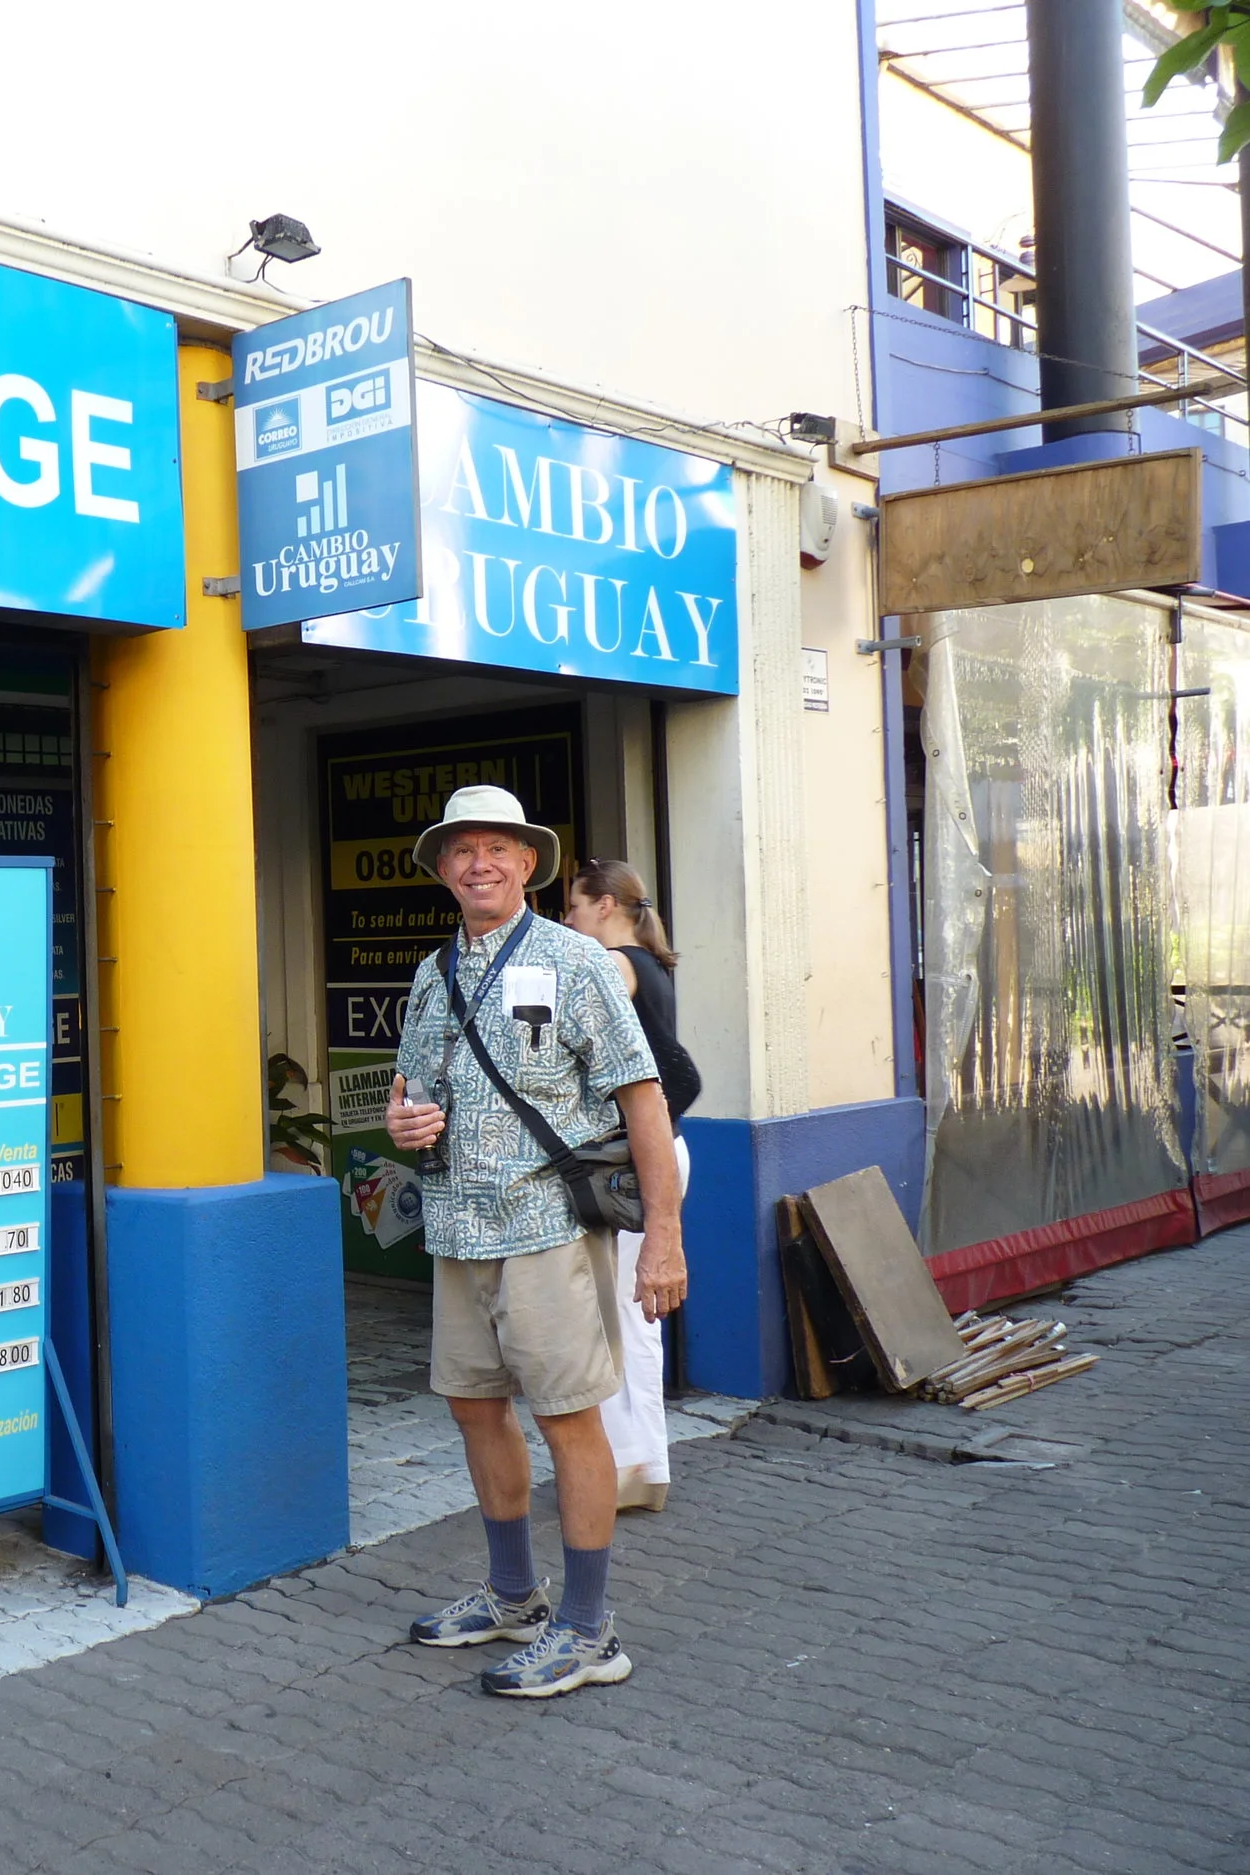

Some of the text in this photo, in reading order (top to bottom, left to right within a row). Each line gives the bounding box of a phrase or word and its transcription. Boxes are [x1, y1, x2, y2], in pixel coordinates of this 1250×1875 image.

[330, 376, 386, 419] DGI
[258, 426, 298, 445] CORREO
[423, 434, 687, 560] AMBIO
[278, 529, 369, 566] CAMBIO
[252, 542, 401, 597] Uruguay
[358, 543, 724, 668] RUGUAY
[342, 758, 506, 801] WESTERN
[392, 793, 451, 823] UN
[355, 848, 431, 881] 080
[351, 910, 365, 929] To
[370, 907, 403, 928] send
[407, 905, 435, 926] and
[351, 947, 382, 966] Para
[477, 967, 496, 998] SONY
